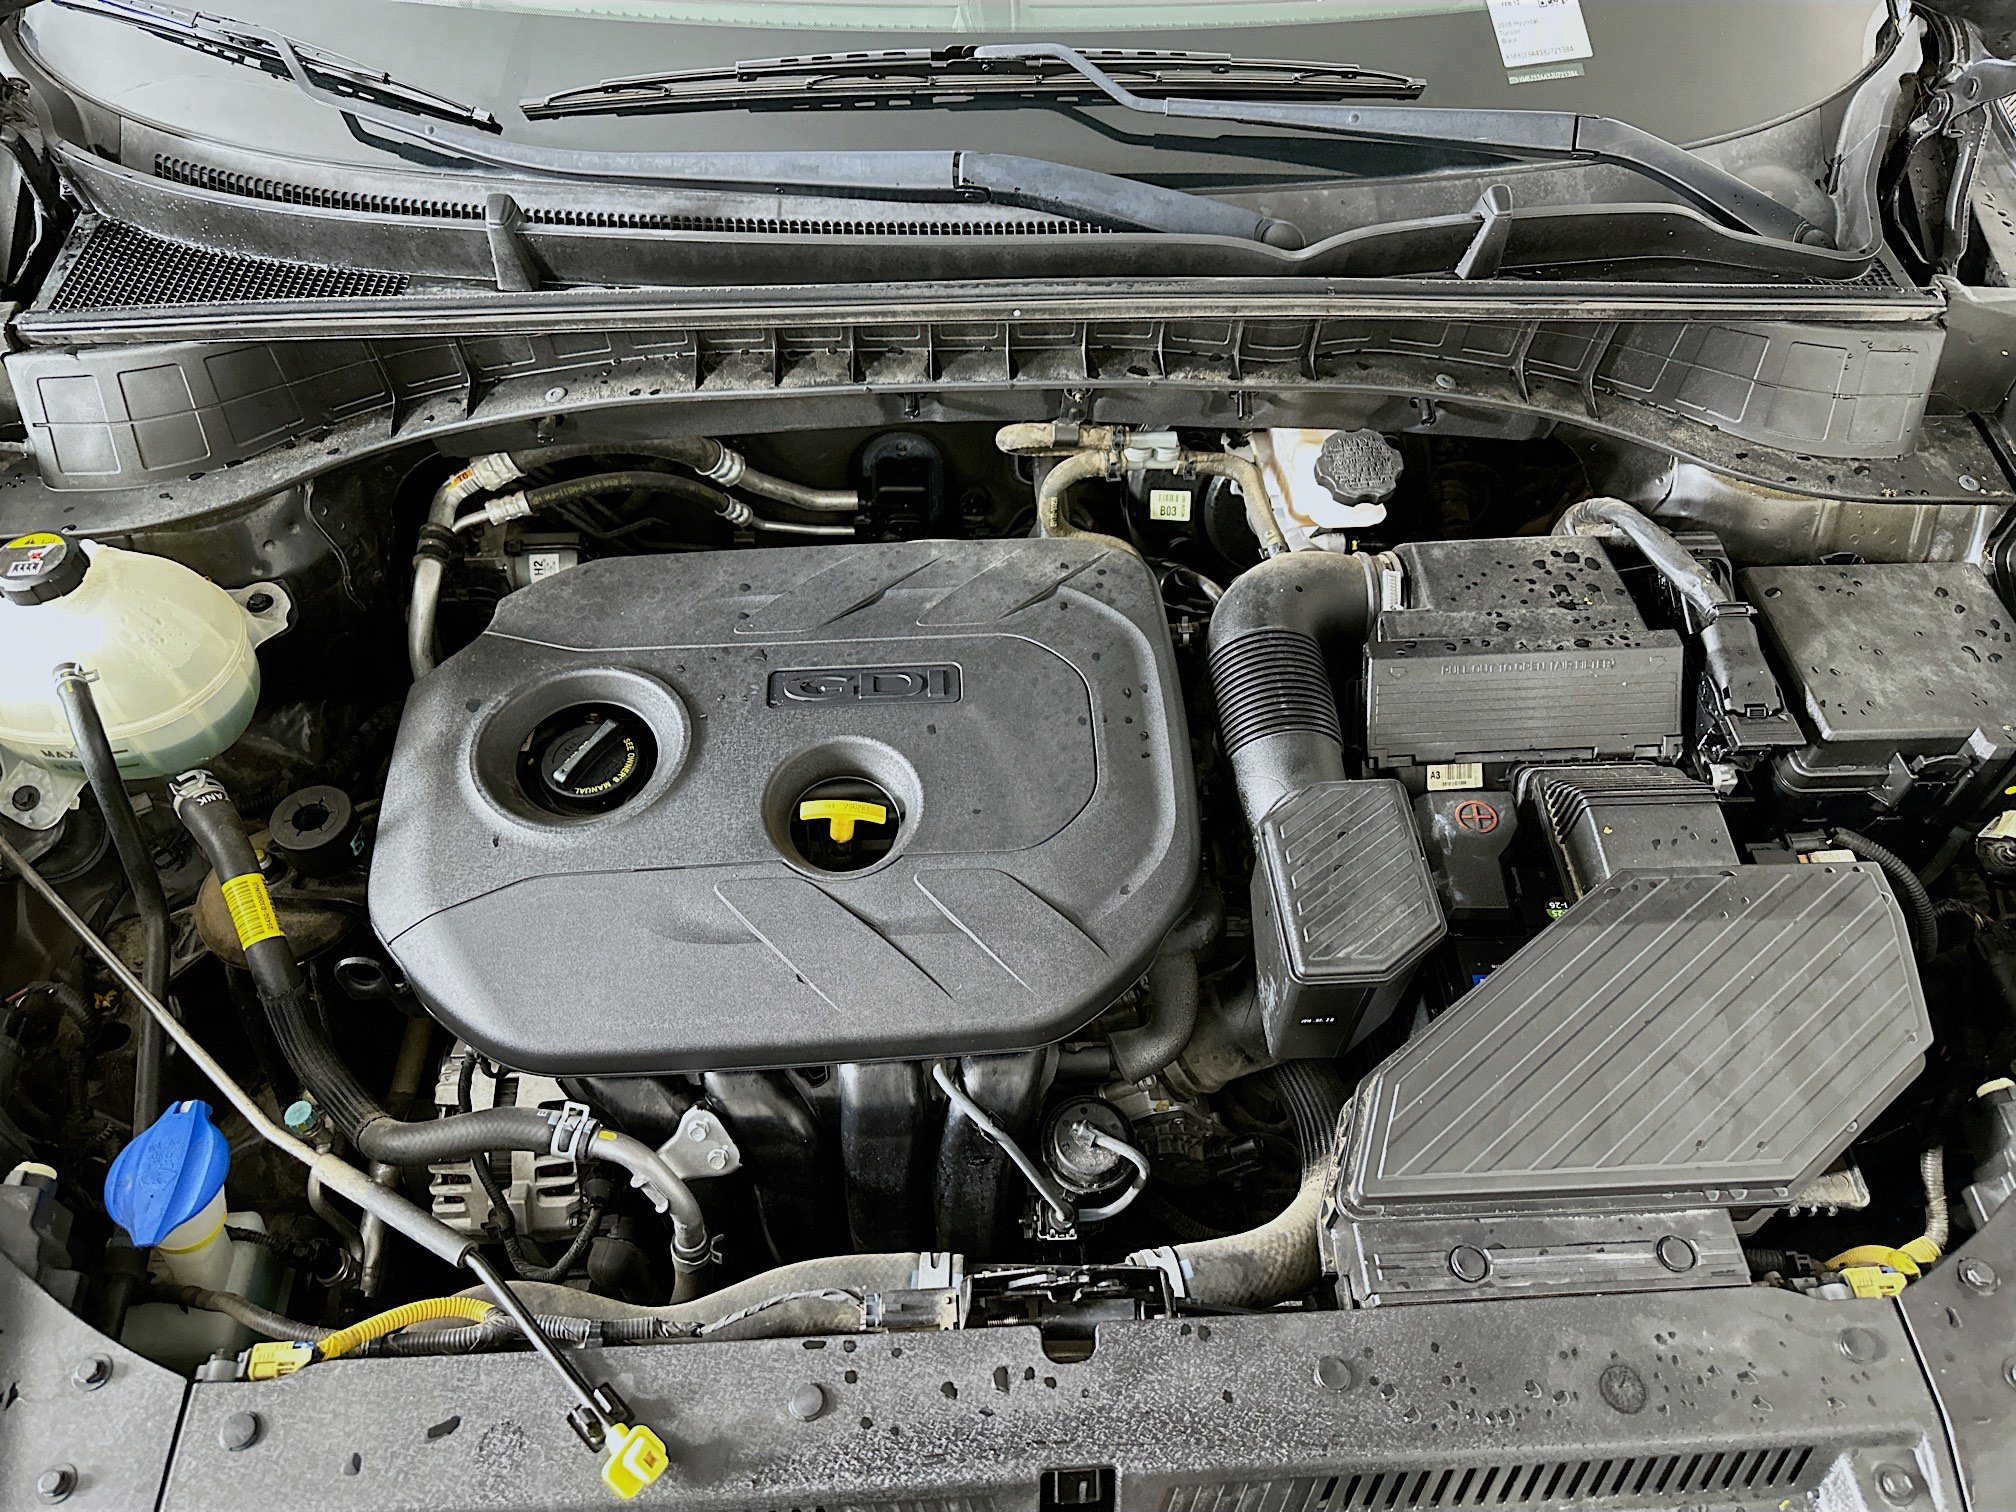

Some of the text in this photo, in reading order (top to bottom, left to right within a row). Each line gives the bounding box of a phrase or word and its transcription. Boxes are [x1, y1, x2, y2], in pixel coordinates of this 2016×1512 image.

[1160, 505, 1177, 517] B03
[533, 560, 544, 576] H2
[1441, 664, 1469, 676] PULL
[1514, 661, 1546, 672] OPEN
[783, 668, 948, 702] GDI
[41, 749, 79, 759] MAX
[574, 737, 636, 795] SEE OWNER'S MANUAL
[1430, 770, 1441, 780] A3
